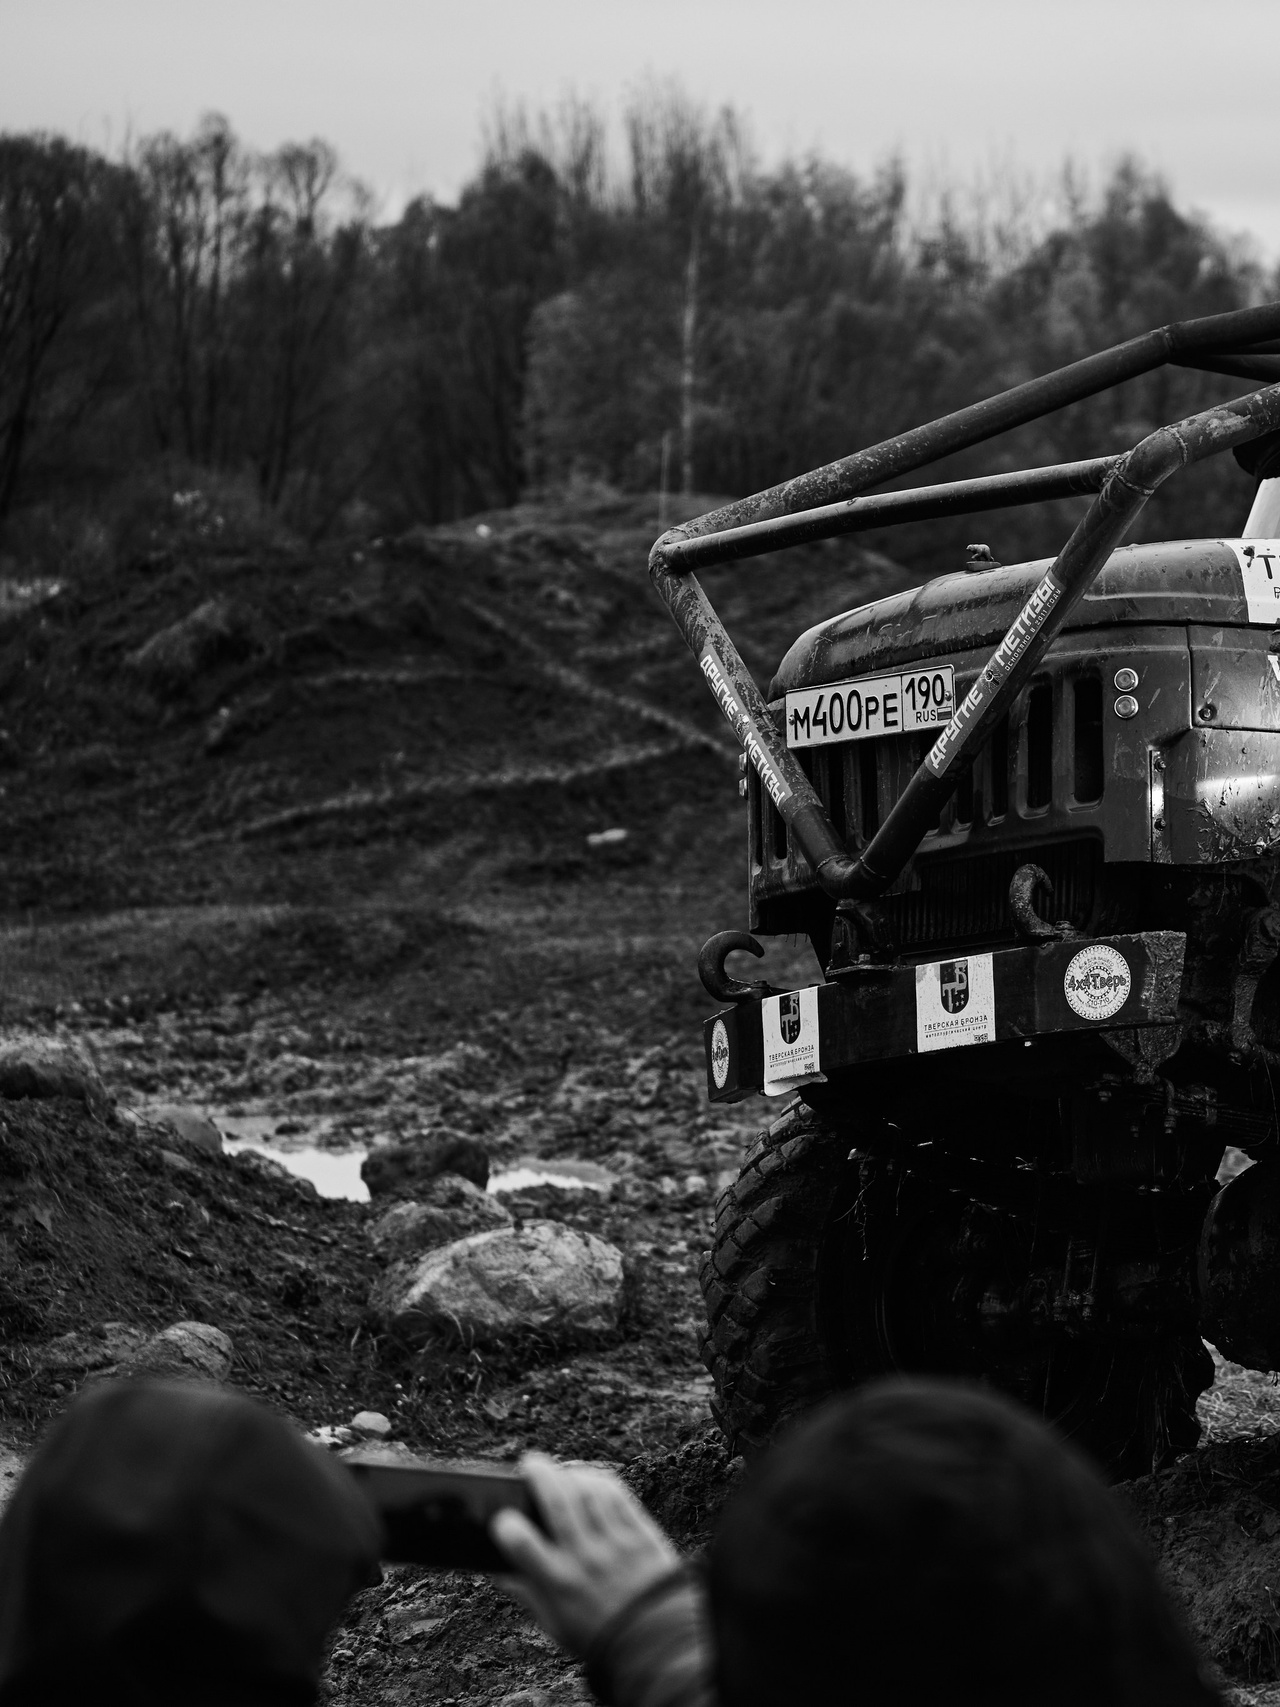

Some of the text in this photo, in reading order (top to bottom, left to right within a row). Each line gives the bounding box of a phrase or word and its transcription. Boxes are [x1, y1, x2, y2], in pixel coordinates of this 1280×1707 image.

[1046, 588, 1062, 608] ГОДУ
[930, 576, 1055, 770] ДРУГИЕ МЕТИЗЫ
[904, 673, 945, 711] 190
[700, 654, 786, 806] ДРУГИЕ МЕТИЗЫ
[915, 709, 937, 723] RUS
[924, 1014, 988, 1031] ТВЕРСКАЯ БРОНЗА
